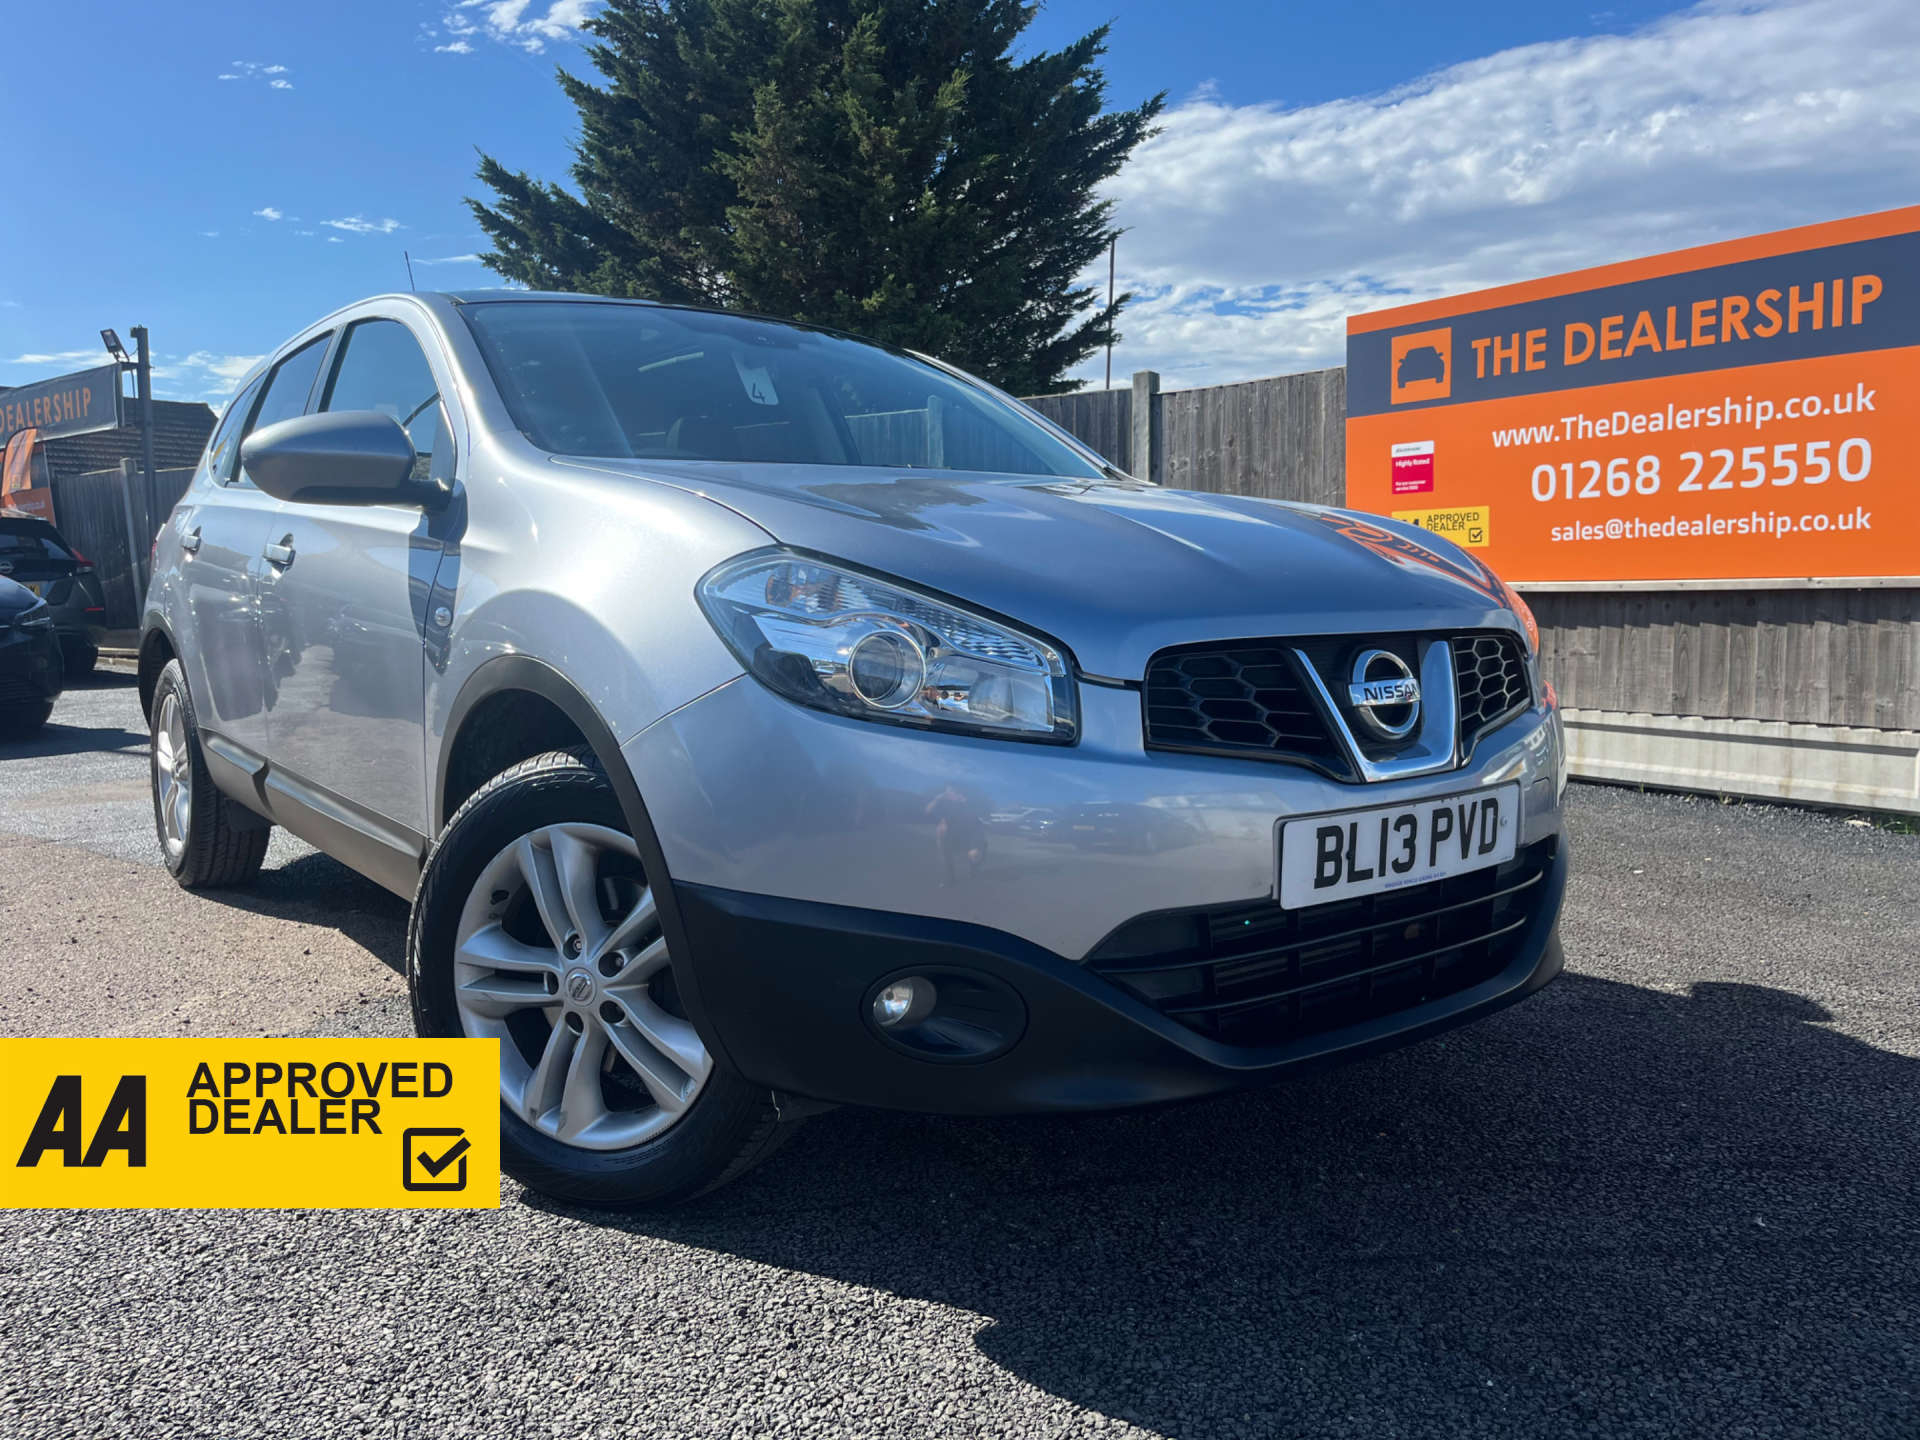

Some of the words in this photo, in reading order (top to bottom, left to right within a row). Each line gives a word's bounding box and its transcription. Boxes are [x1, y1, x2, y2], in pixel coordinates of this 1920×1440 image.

[1471, 328, 1547, 379] THE
[1563, 274, 1883, 366] DEALERSHIP
[1491, 382, 1876, 448] www.TheDealership.co.uk
[1530, 455, 1661, 502] 01268
[1677, 437, 1872, 492] 225550
[1426, 512, 1480, 523] APPROVED
[1426, 521, 1465, 532] DEALER
[1551, 506, 1872, 542] sales@thedealership.co.uk
[1363, 683, 1418, 701] NISSAN
[1313, 813, 1418, 890] BL13
[1428, 797, 1499, 868] PVD
